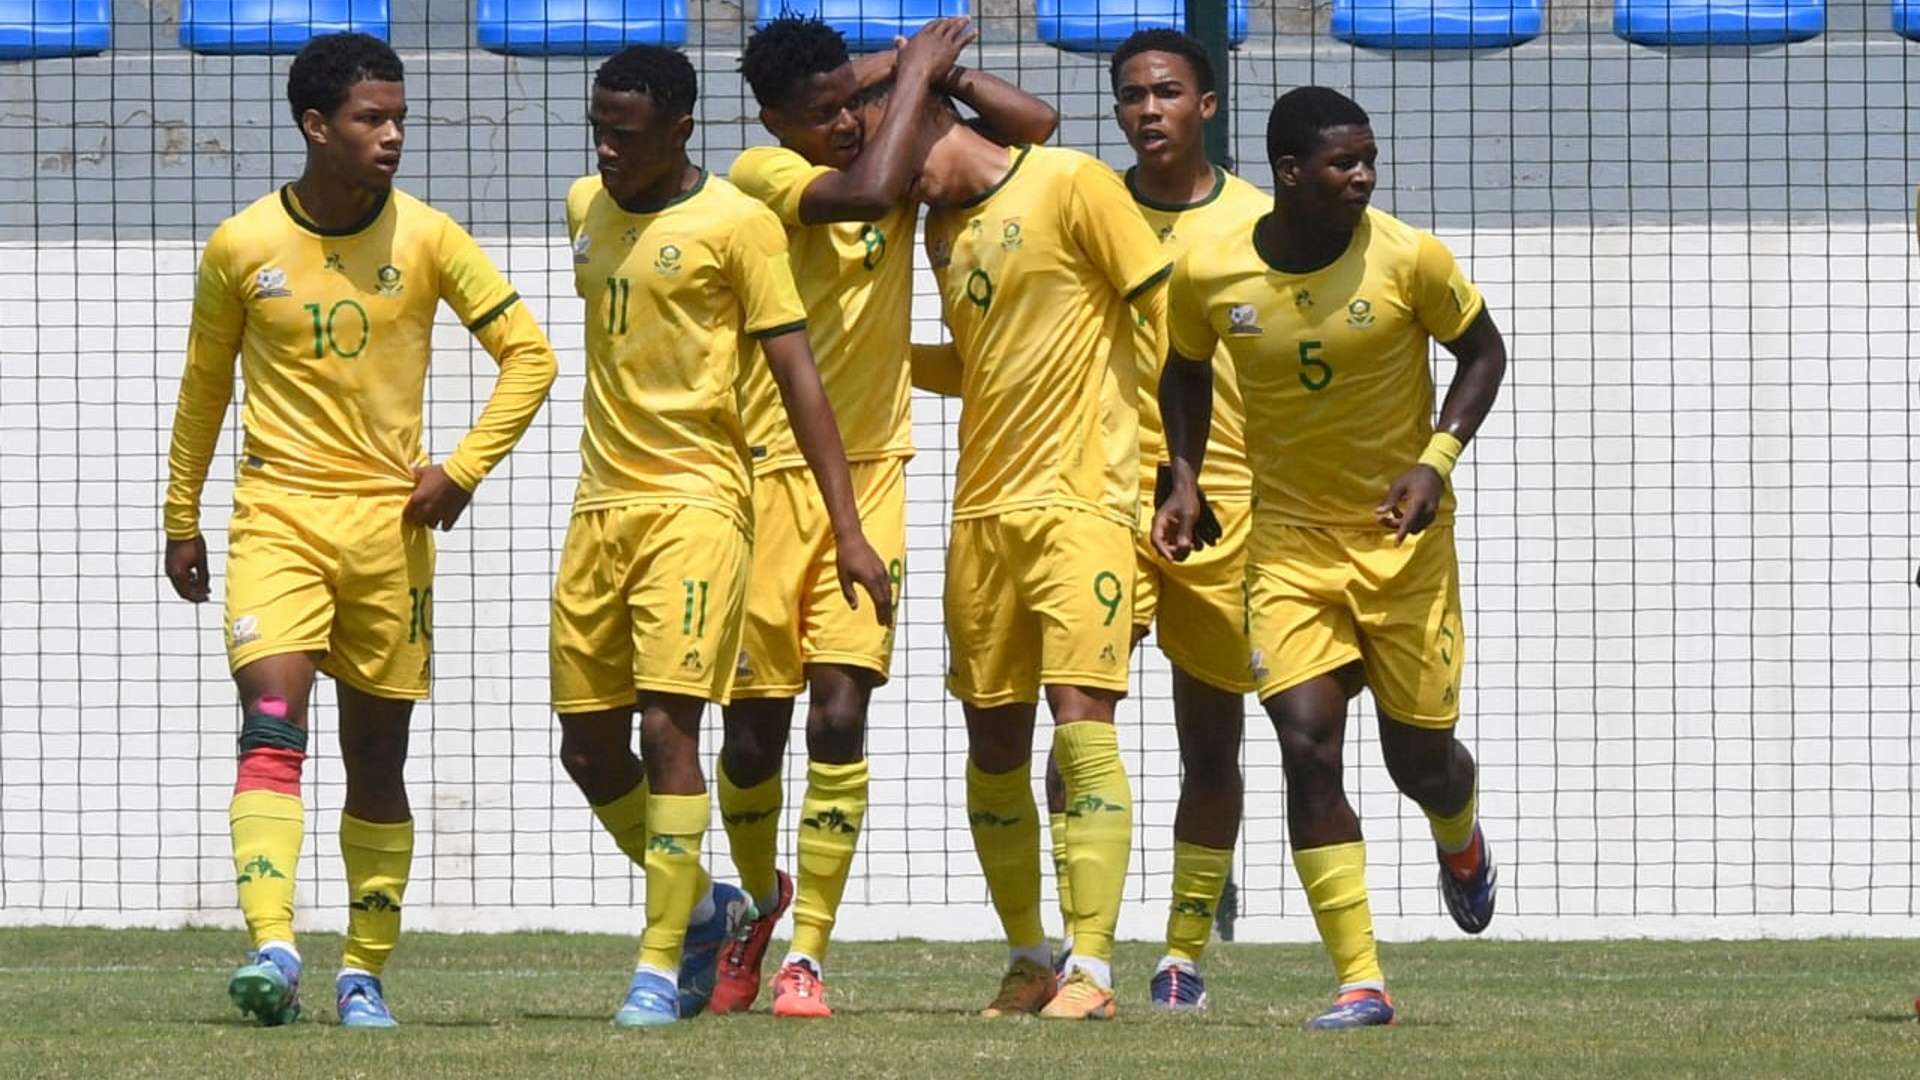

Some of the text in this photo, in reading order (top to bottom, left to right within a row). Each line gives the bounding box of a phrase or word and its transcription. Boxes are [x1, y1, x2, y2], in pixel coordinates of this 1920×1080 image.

[862, 224, 885, 271] 8
[606, 277, 629, 335] 11
[967, 268, 992, 320] 9
[304, 300, 369, 360] 10
[1299, 341, 1333, 391] 5
[683, 580, 709, 638] 11
[1094, 571, 1122, 626] 9
